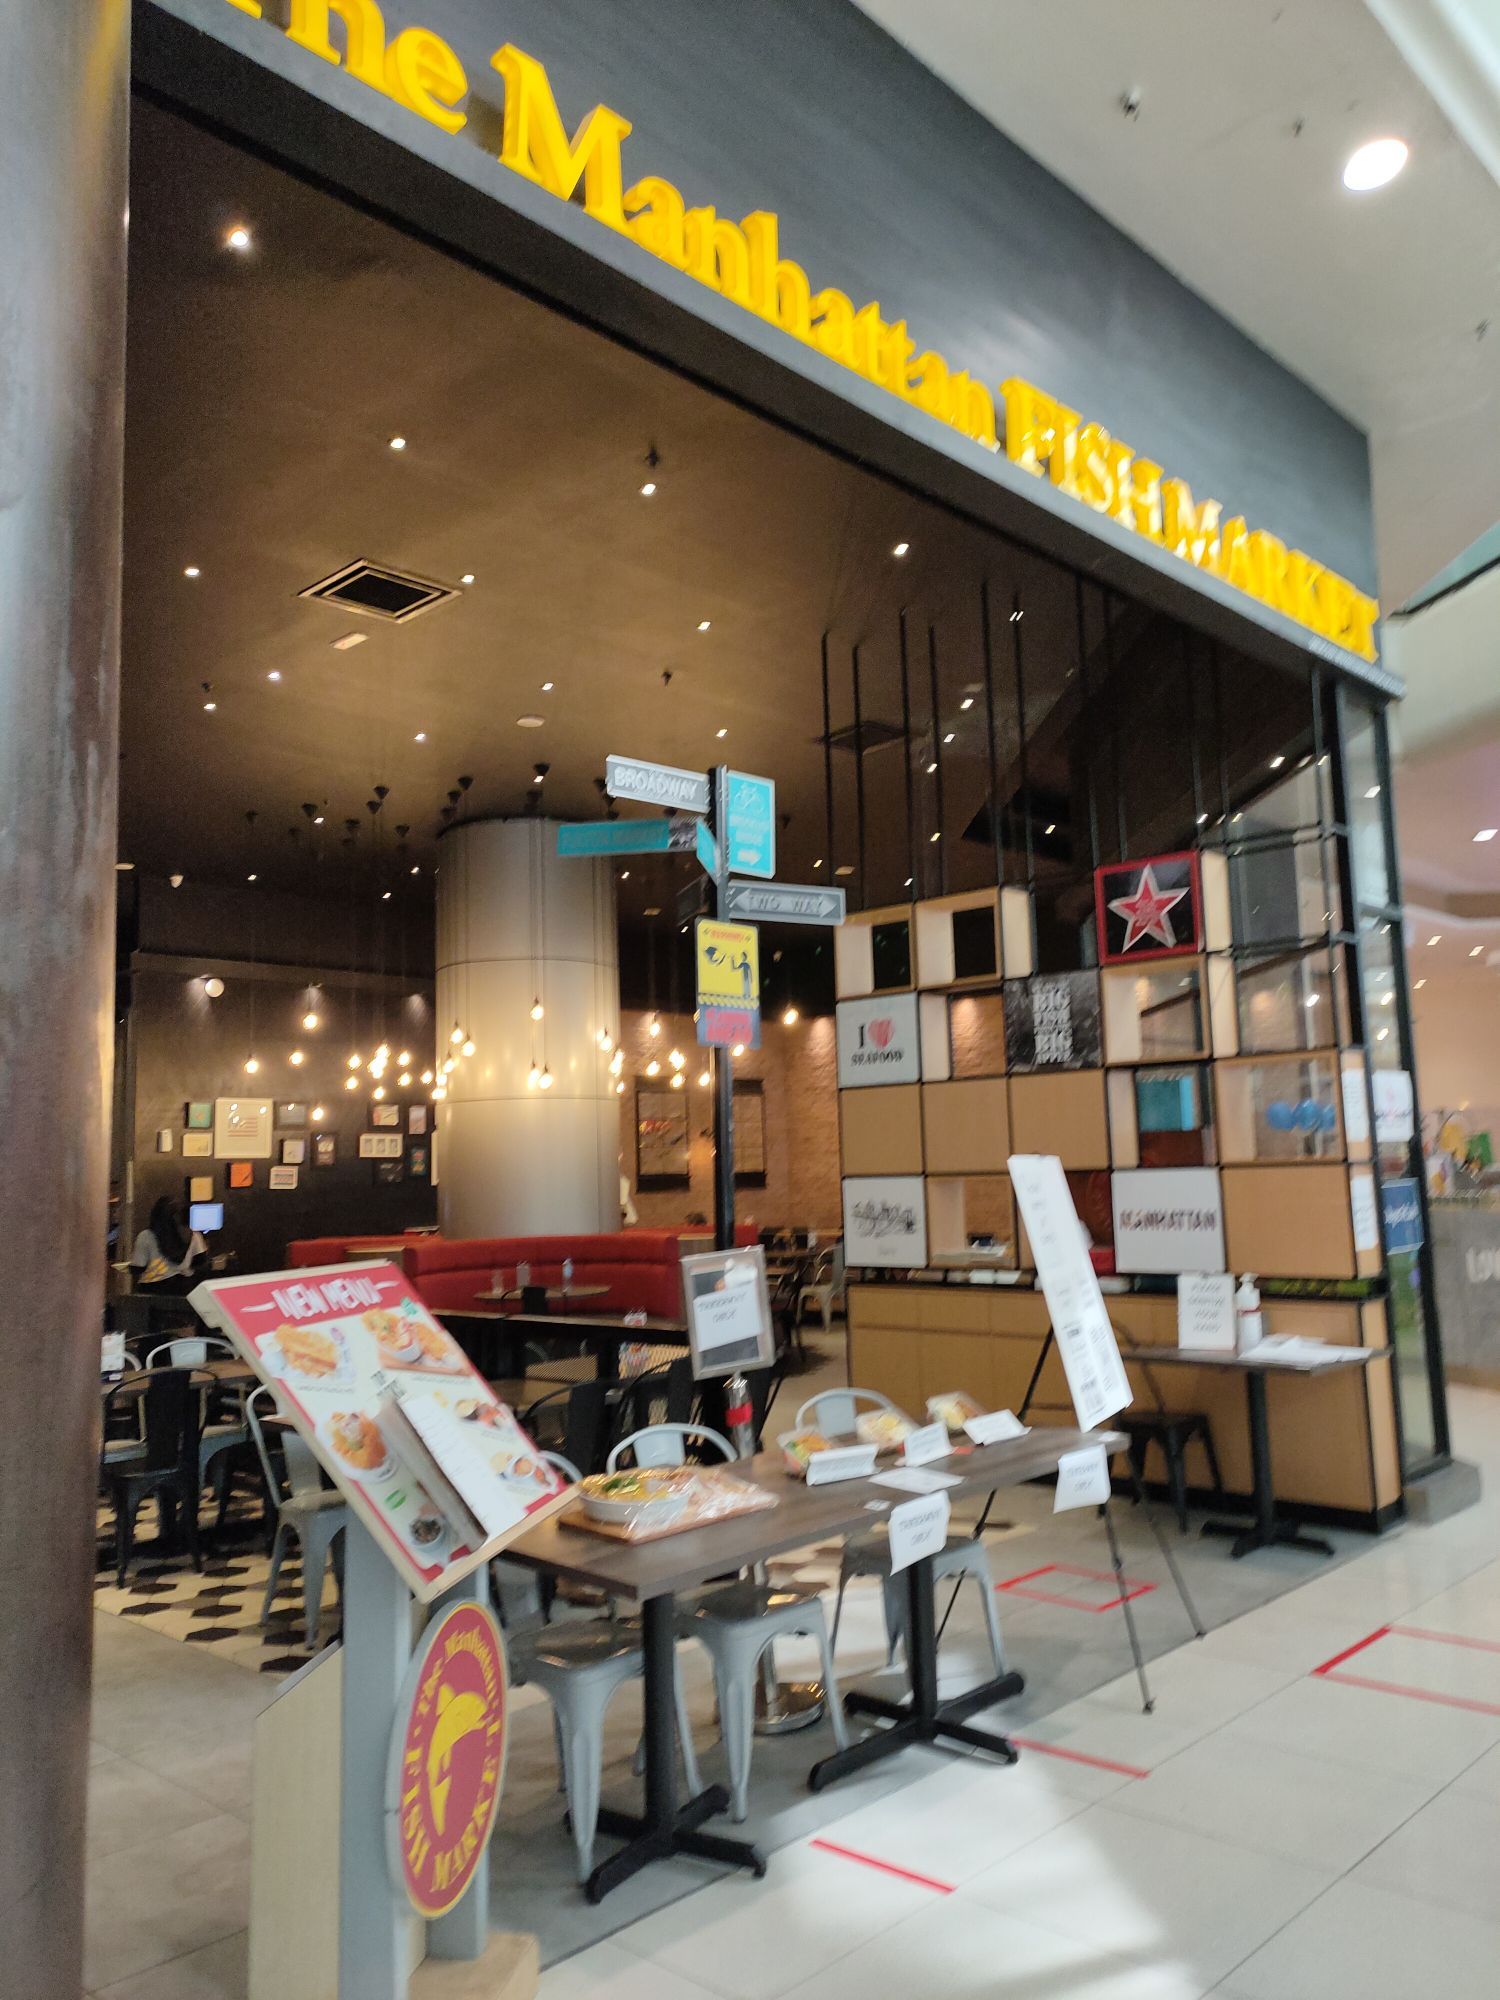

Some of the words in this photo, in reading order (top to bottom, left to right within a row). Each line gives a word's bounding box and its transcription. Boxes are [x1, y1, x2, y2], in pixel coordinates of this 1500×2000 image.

[225, 0, 469, 136] he
[489, 42, 1001, 454] Manhattan
[1000, 376, 1165, 548] FISH
[1162, 477, 1381, 664] MARKET
[613, 765, 698, 801] BROADWAY
[857, 1022, 867, 1051] I
[1119, 1209, 1218, 1232] MANHATTAN
[271, 1282, 329, 1320] NEW
[320, 1276, 383, 1312] MENU
